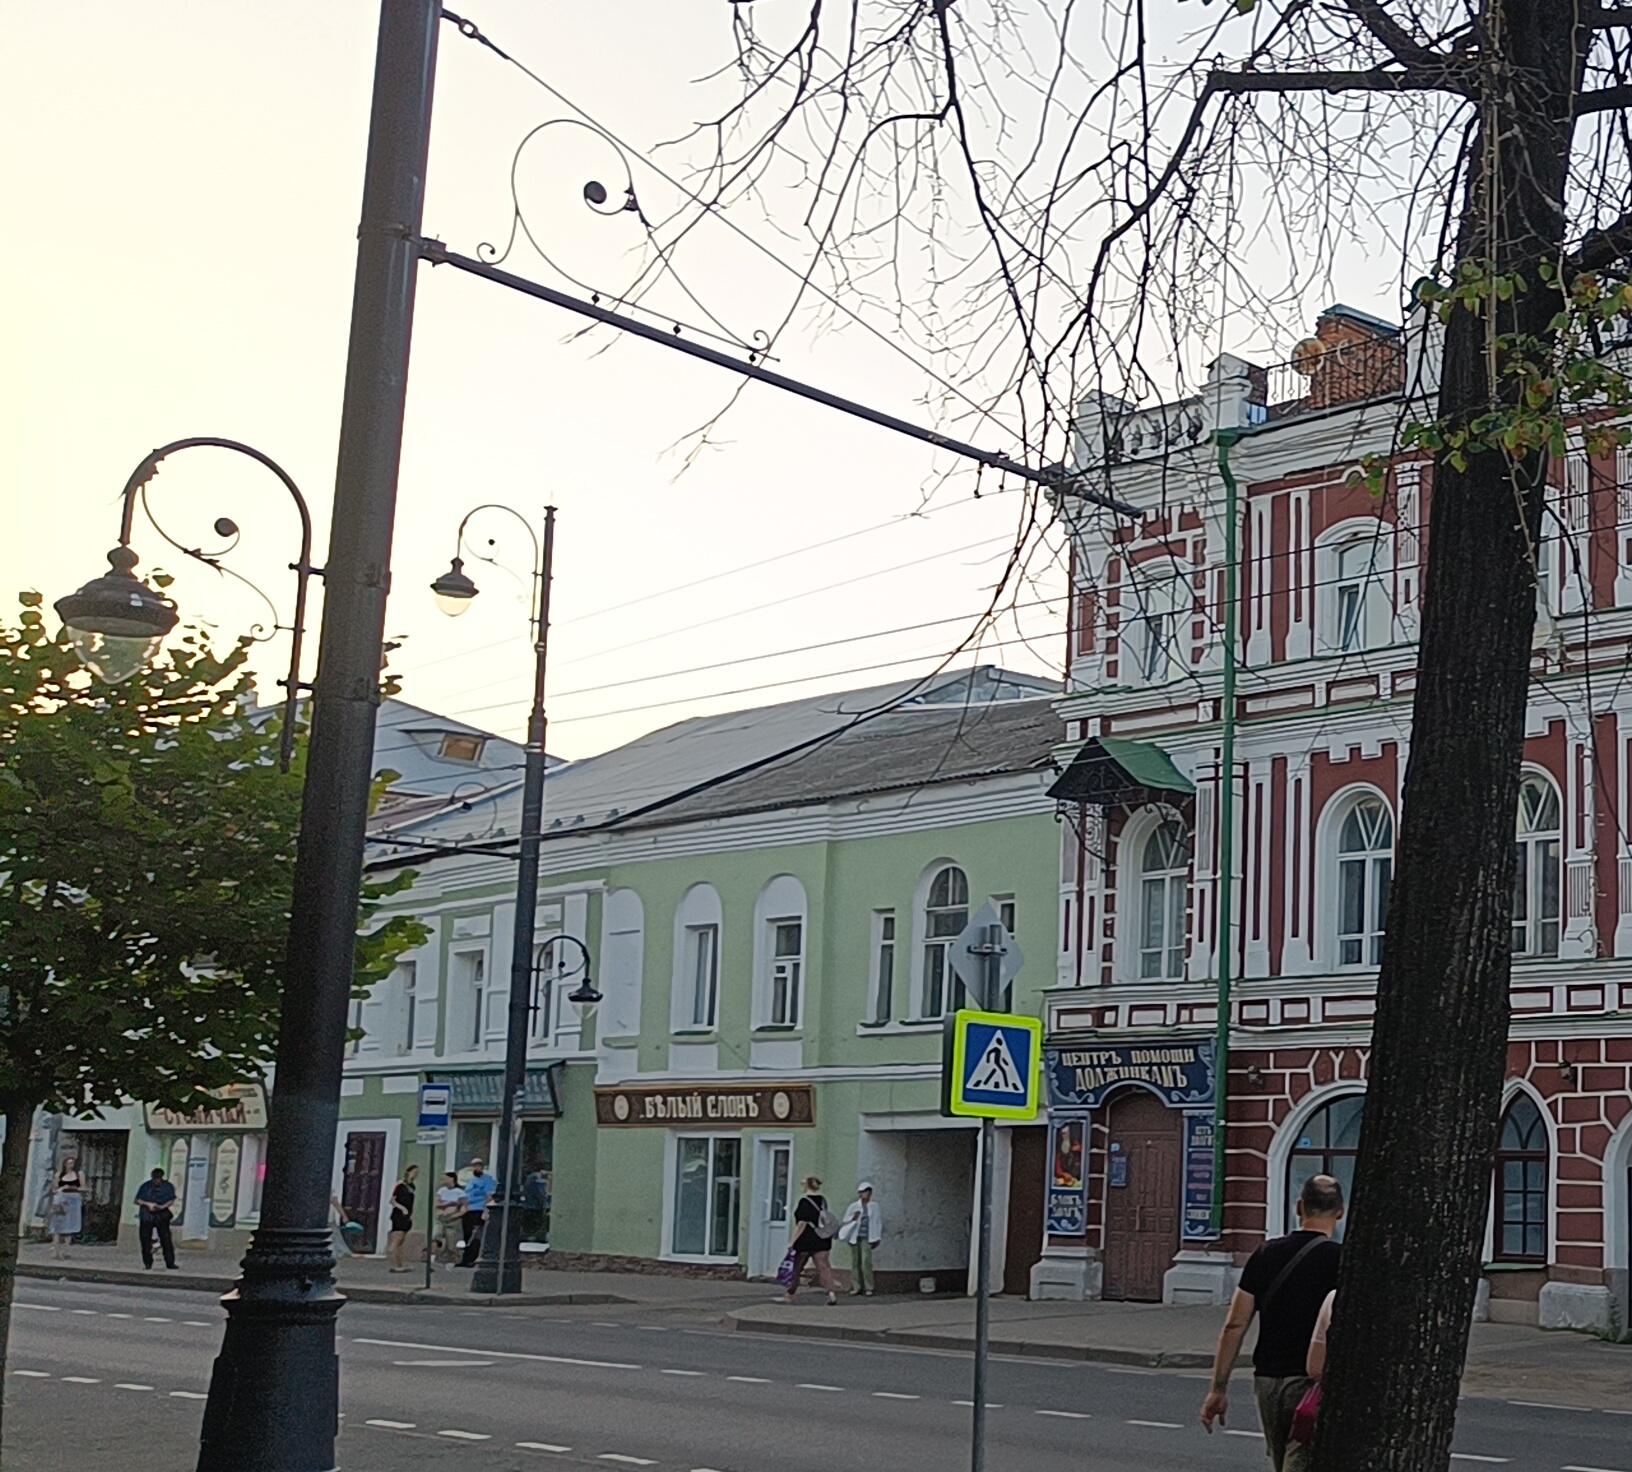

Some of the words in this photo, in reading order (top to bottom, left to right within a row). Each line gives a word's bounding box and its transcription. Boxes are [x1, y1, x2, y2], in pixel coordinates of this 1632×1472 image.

[1061, 1050, 1122, 1067] ЦЕНТРЪ
[1130, 1048, 1195, 1065] ПОМОЩИ
[1075, 1065, 1188, 1091] ДОЛЖНИКАМЪ
